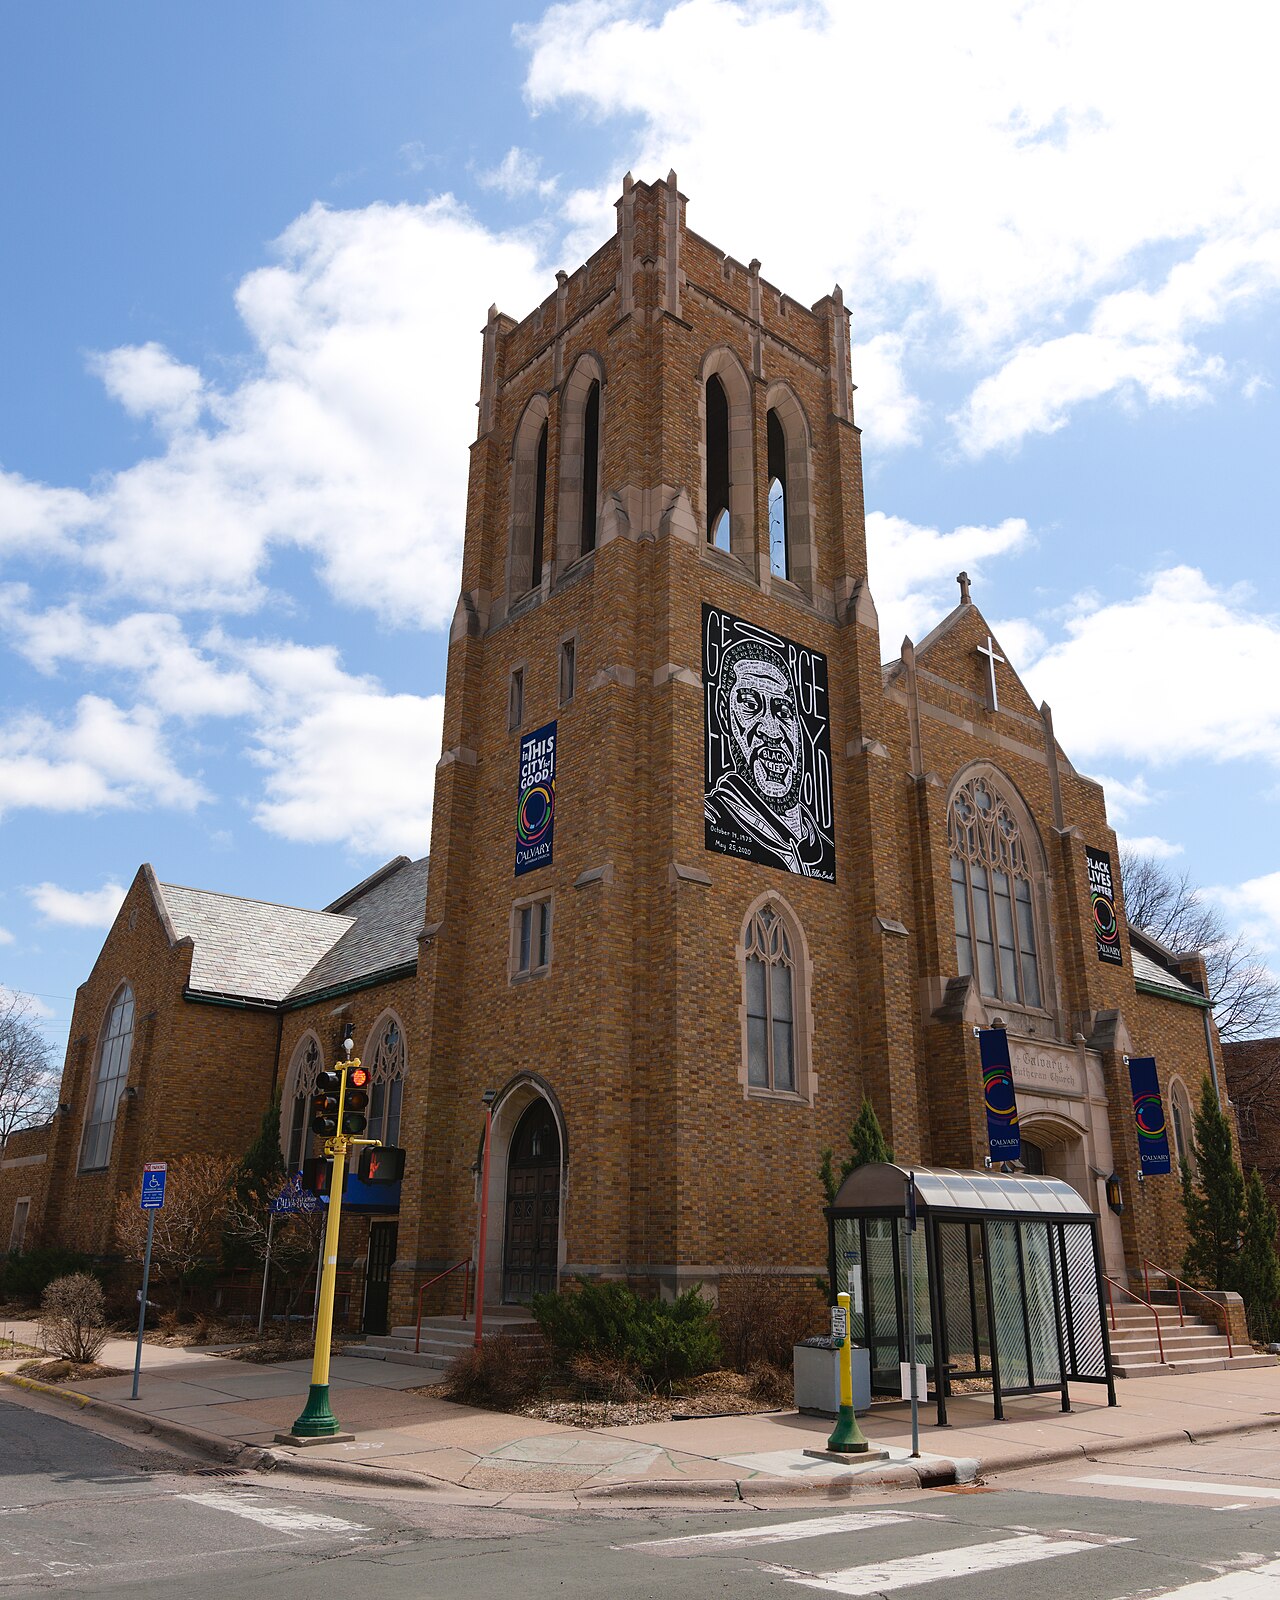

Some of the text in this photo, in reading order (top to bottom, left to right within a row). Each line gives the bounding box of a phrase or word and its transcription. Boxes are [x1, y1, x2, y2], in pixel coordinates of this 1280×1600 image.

[731, 645, 746, 655] BLACK
[747, 643, 763, 651] BLACK
[764, 647, 781, 664] BLACK
[706, 610, 827, 721] GEORGE
[523, 736, 554, 761] THIS
[762, 749, 788, 763] BLACK
[521, 756, 546, 777] CITY
[766, 762, 785, 772] LIFE
[741, 771, 759, 792] BLACK
[710, 824, 730, 836] October
[516, 841, 552, 865] CALVARY
[714, 839, 727, 852] May
[1087, 868, 1112, 888] LIVES
[1022, 1052, 1064, 1073] Calvary
[1013, 1065, 1075, 1086] Lutheran Church
[990, 1138, 1019, 1147] CALVARY
[1141, 1154, 1169, 1162] CALVARY
